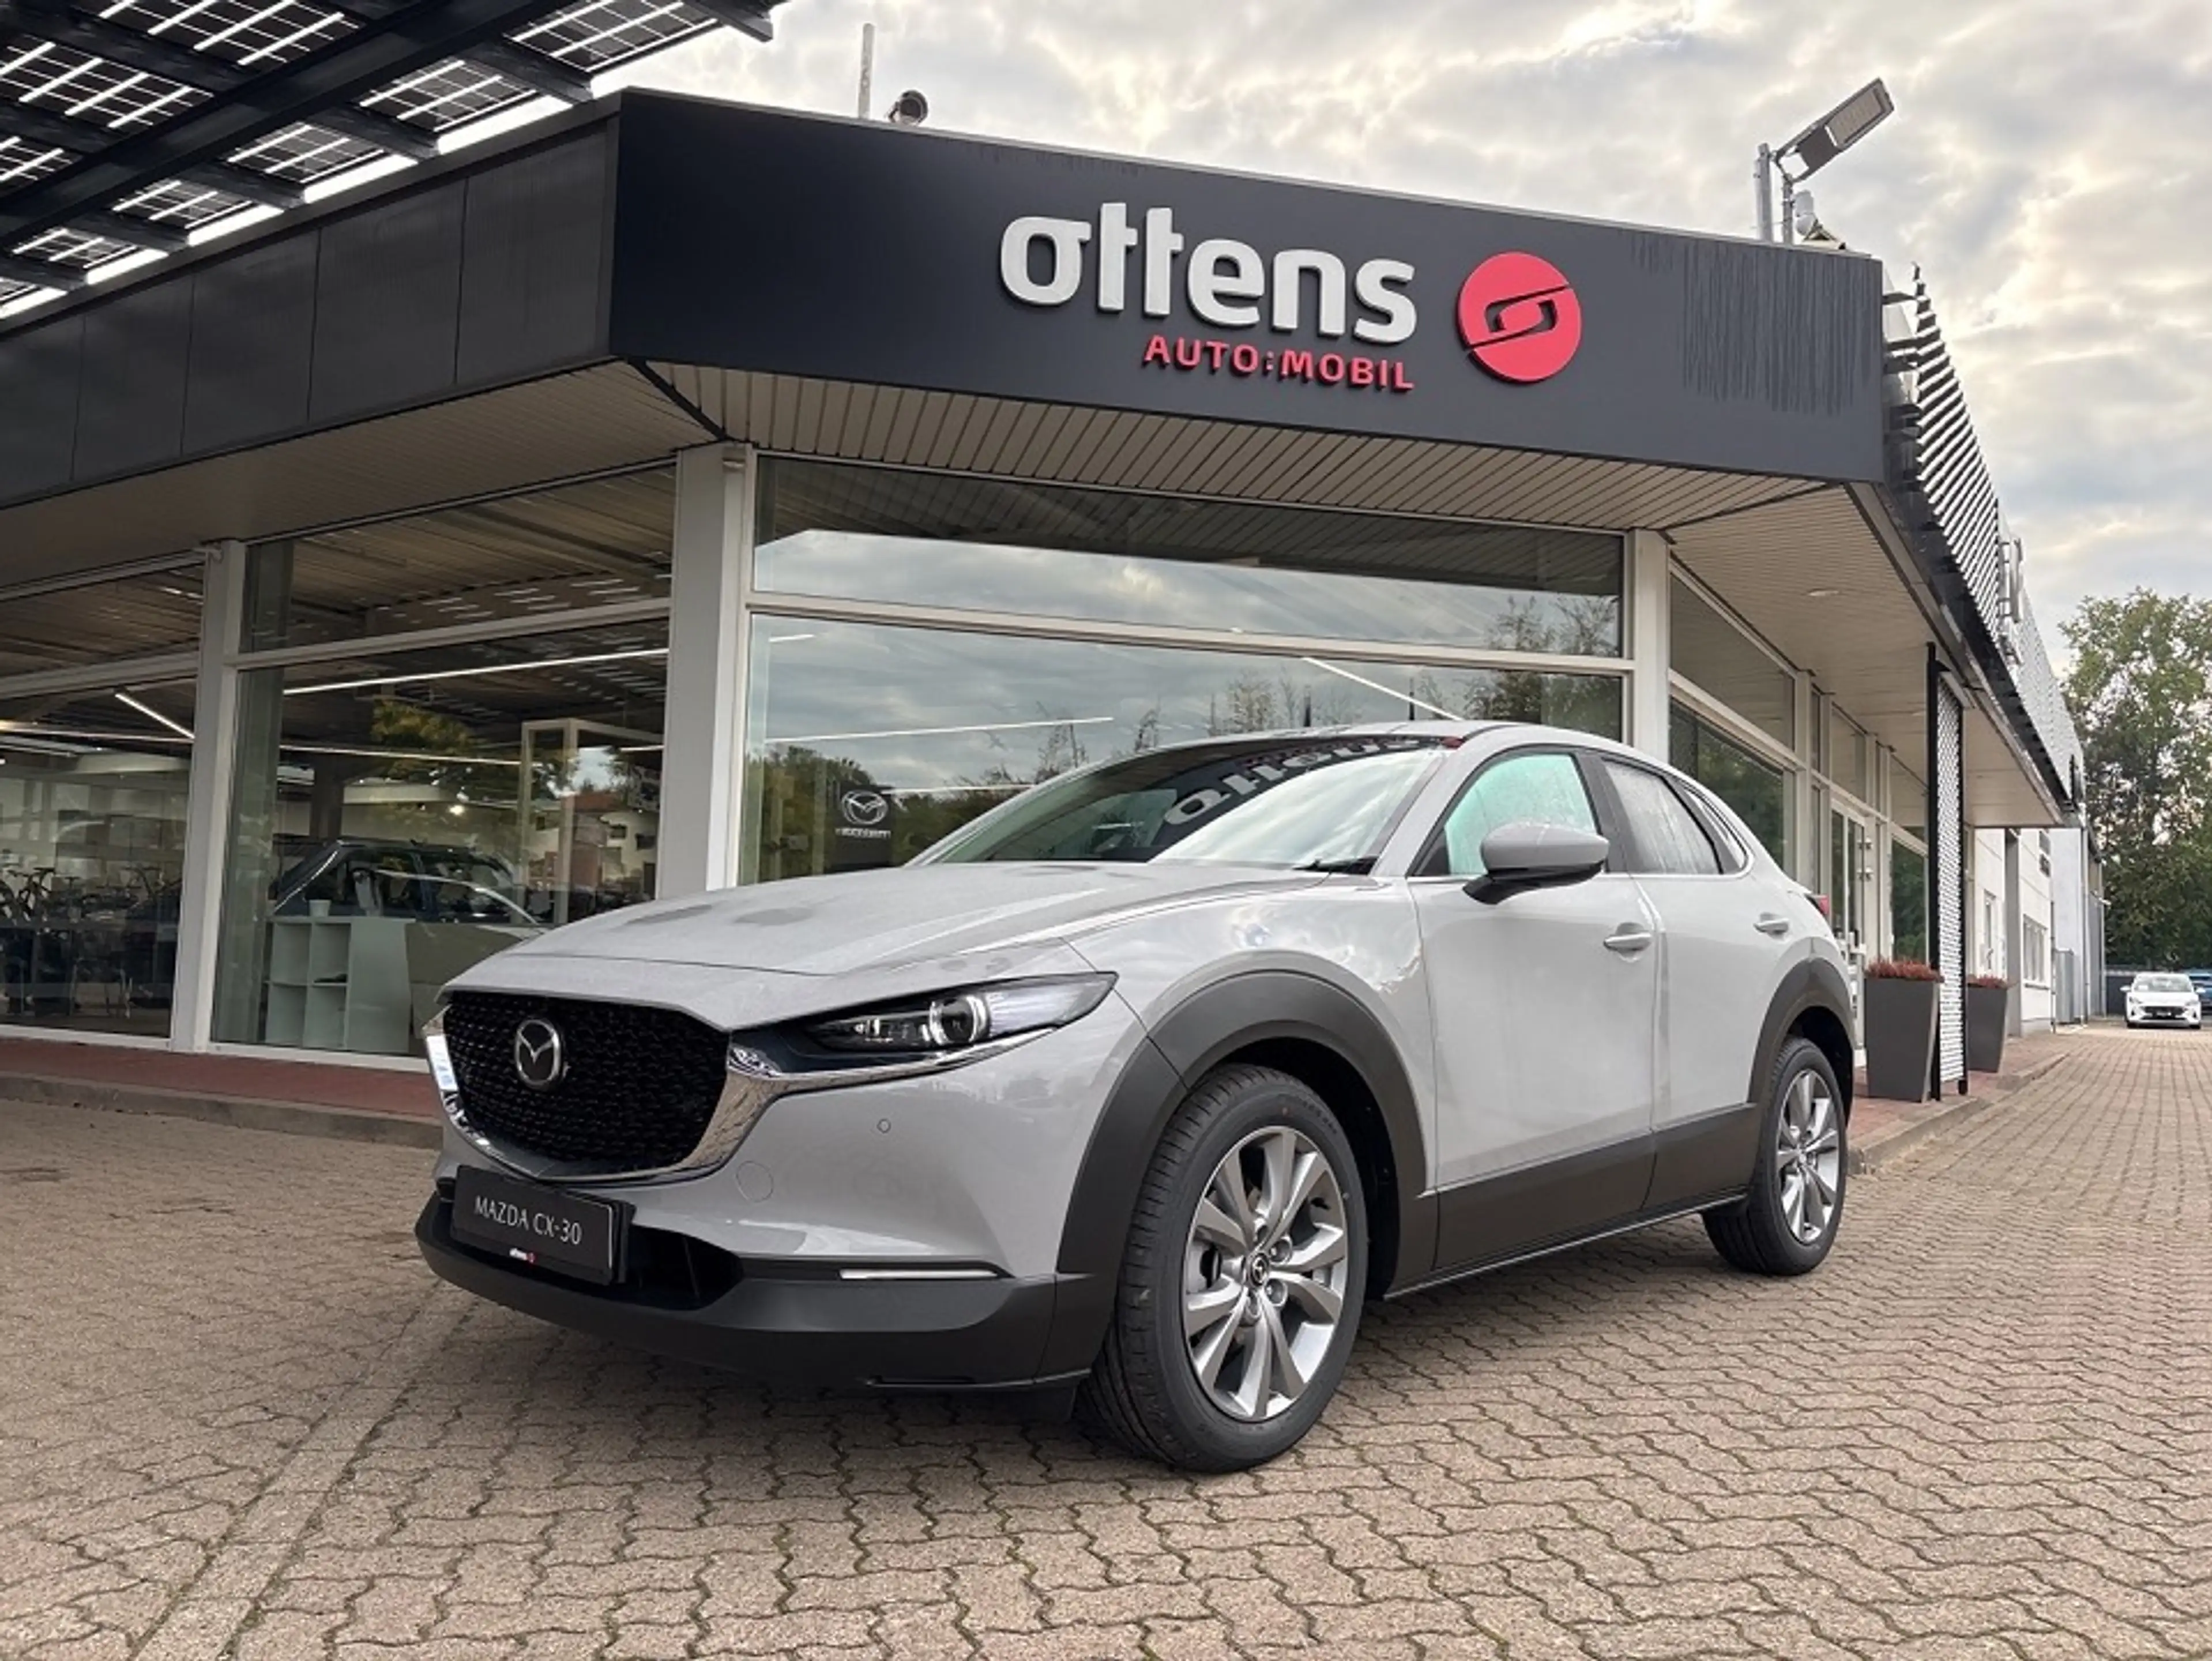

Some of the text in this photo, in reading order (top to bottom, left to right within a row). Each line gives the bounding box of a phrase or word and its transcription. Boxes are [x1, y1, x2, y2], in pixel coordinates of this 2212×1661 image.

[1000, 202, 1417, 344] ottens
[1145, 336, 1415, 392] AUTO:MOBIL
[474, 1195, 582, 1246] MAZDA CX-30
